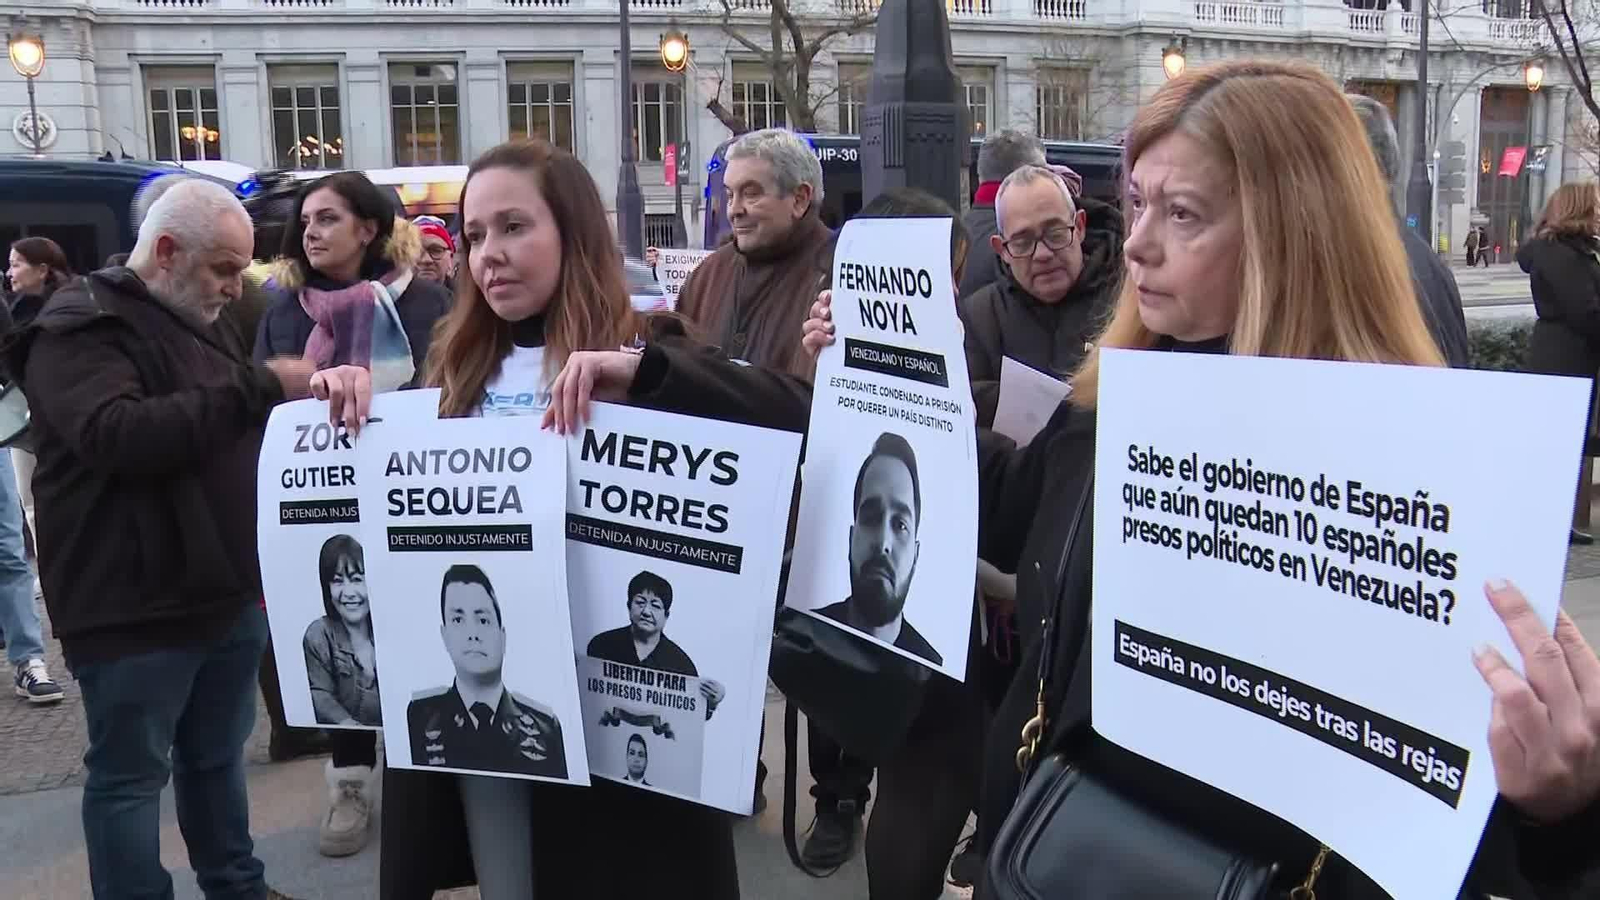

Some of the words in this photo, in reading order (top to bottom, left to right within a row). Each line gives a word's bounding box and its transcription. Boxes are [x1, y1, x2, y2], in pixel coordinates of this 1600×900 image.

[665, 254, 706, 265] EXIGIMO
[839, 262, 932, 299] FERNANDO
[858, 298, 918, 336] NOYA
[850, 346, 897, 366] VENEZOLANO
[897, 354, 903, 367] Y
[905, 355, 941, 376] ESPAÑOL
[838, 396, 855, 409] POR
[857, 400, 887, 417] QUERER
[888, 407, 899, 418] UN
[900, 409, 917, 424] PAÍS
[919, 414, 953, 433] DISTINTO
[879, 386, 924, 406] CONDENADO
[925, 397, 930, 407] A
[931, 397, 962, 416] PRISIÓN
[294, 420, 353, 453] ZOR
[385, 446, 532, 476] ANTONIO
[580, 428, 740, 486] MERYS
[281, 465, 356, 489] GUTIER
[1128, 444, 1174, 478] Sabe
[1179, 452, 1197, 482] el
[1203, 458, 1305, 502] gobierno
[1310, 473, 1340, 510] de
[1347, 480, 1450, 533] España
[282, 507, 328, 519] DETENIDA
[329, 506, 359, 517] INJUS
[387, 485, 523, 516] SEQUEA
[579, 479, 729, 533] TORRES
[390, 534, 443, 546] DETENIDO
[445, 533, 528, 546] INJUSTAMENTE
[569, 521, 632, 546] DETENIDA
[635, 536, 737, 567] INJUSTAMENTE
[1122, 482, 1156, 512] que
[1160, 486, 1199, 519] aún
[1205, 499, 1289, 538] quedan
[1294, 510, 1318, 545] 10
[1323, 525, 1458, 580] españoles
[1122, 516, 1182, 550] presos
[1187, 528, 1274, 572] políticos
[1279, 552, 1306, 582] en
[1311, 553, 1456, 625] Venezuela?
[603, 662, 654, 686] LIBERTAD
[657, 674, 687, 692] PARA
[587, 678, 604, 693] LOS
[606, 682, 642, 702] PRESOS
[646, 689, 696, 711] POLÍTICOS
[1119, 633, 1185, 675] España
[1190, 660, 1216, 684] no
[1221, 666, 1250, 698] los
[1255, 680, 1312, 721] dejes
[1315, 702, 1359, 742] tras
[1363, 720, 1397, 760] las
[1402, 747, 1463, 791] rejas
